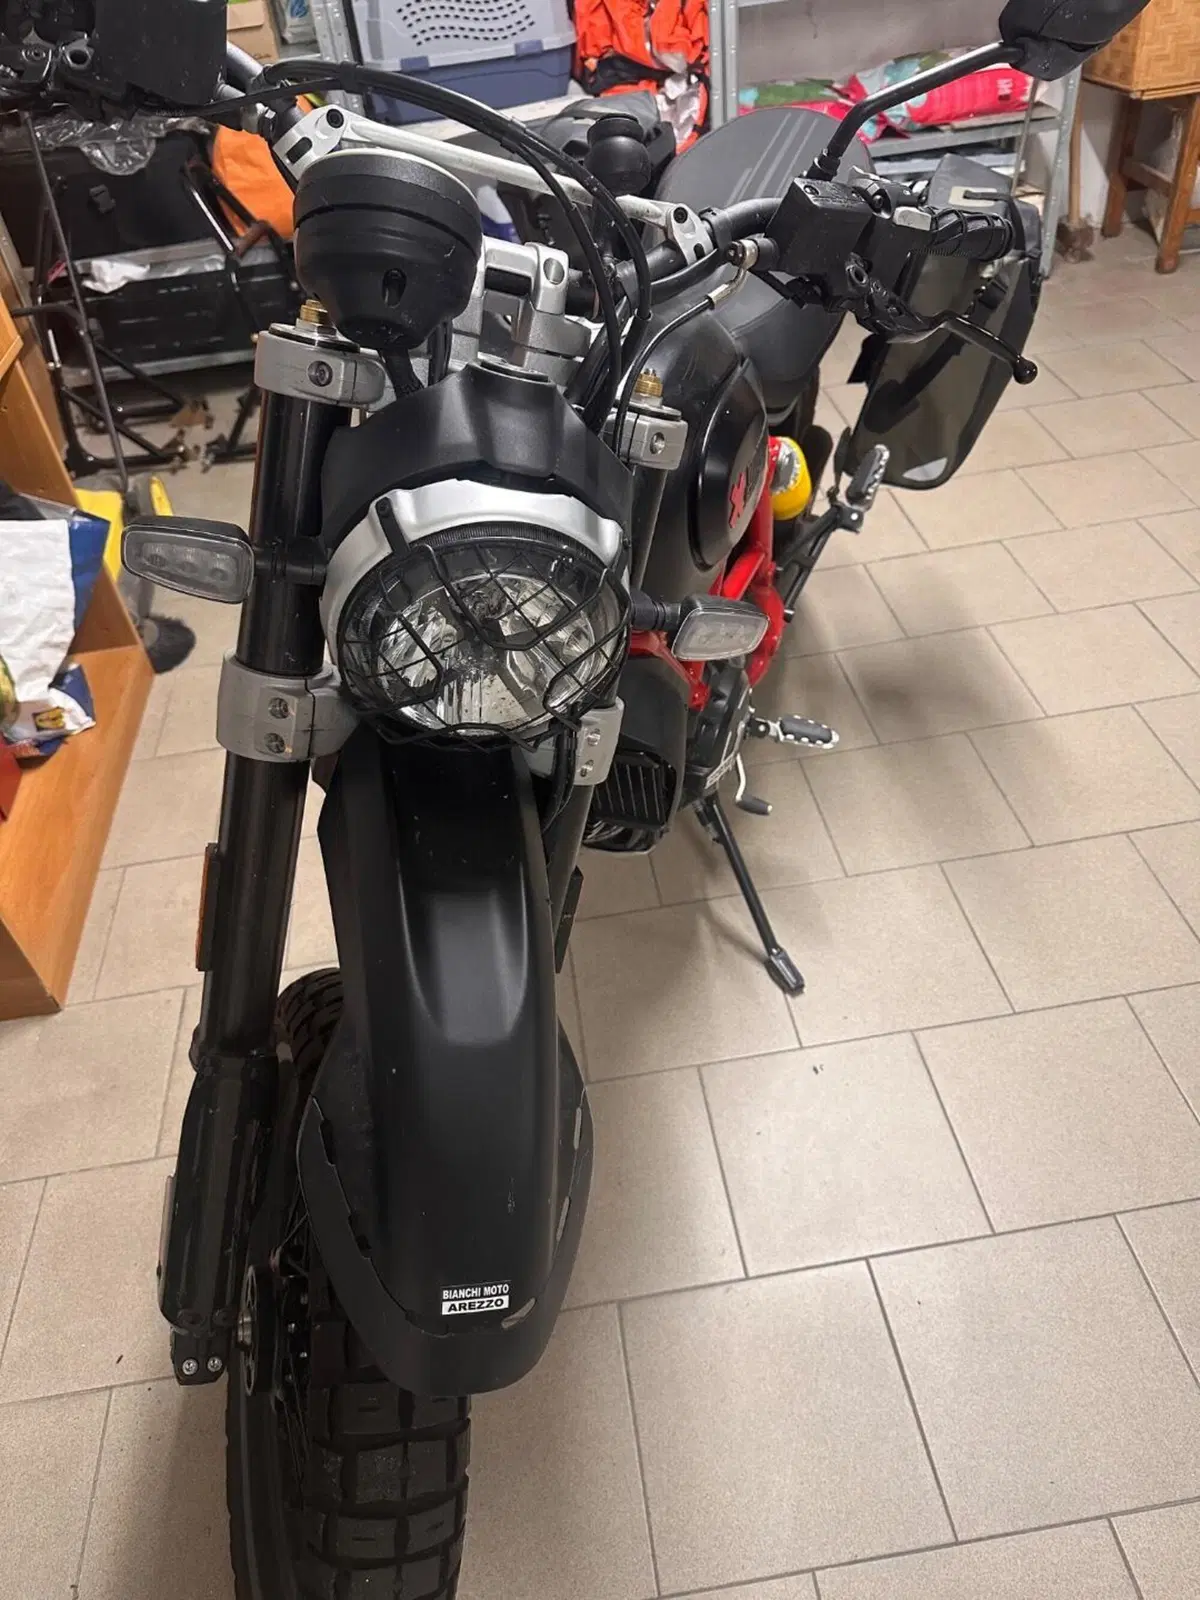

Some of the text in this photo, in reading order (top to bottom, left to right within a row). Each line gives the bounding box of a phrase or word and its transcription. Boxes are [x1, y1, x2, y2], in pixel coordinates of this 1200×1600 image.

[442, 1283, 510, 1300] BIANCHI MOTO
[447, 1298, 504, 1313] AREZZO
